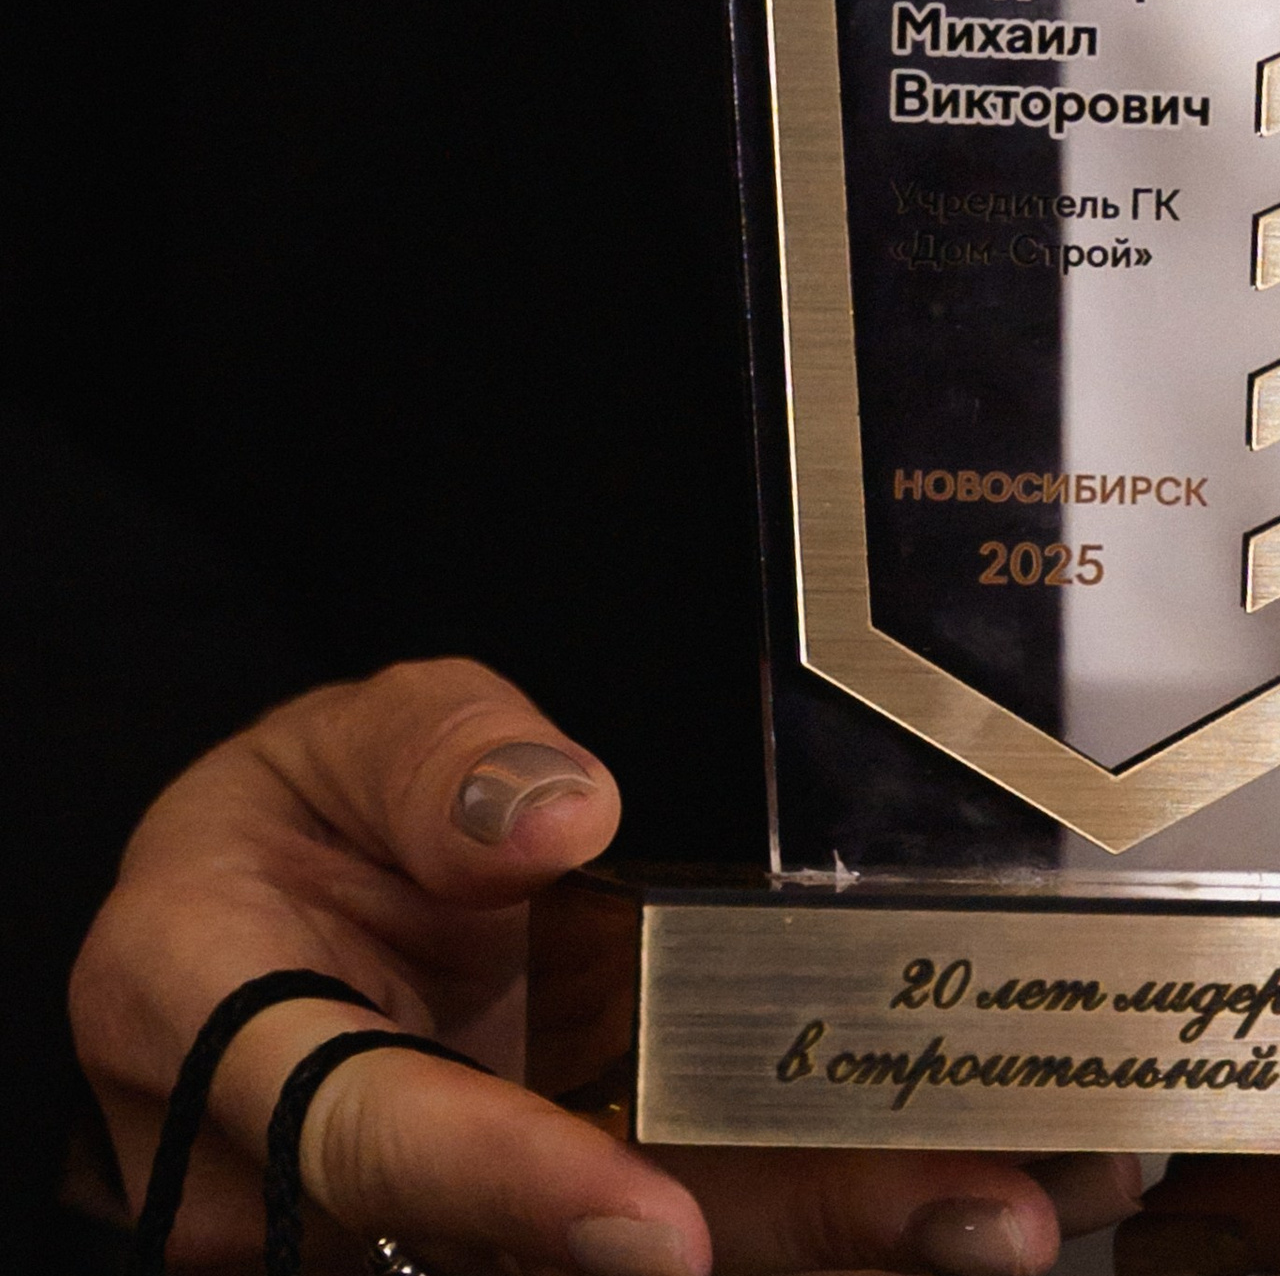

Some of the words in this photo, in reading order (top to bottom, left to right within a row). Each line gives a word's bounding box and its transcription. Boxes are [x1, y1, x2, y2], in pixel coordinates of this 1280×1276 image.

[895, 5, 1098, 57] Михаил
[893, 72, 1210, 135] Викторович
[891, 181, 1120, 224] Учредитель
[1132, 188, 1181, 221] ГК
[893, 469, 1209, 507] НОВОСИБИРСК
[978, 541, 1105, 586] 2025
[889, 958, 973, 1010] 20
[975, 978, 1107, 1012] лет
[776, 1020, 825, 1084] в
[826, 1035, 1280, 1112] строительной
